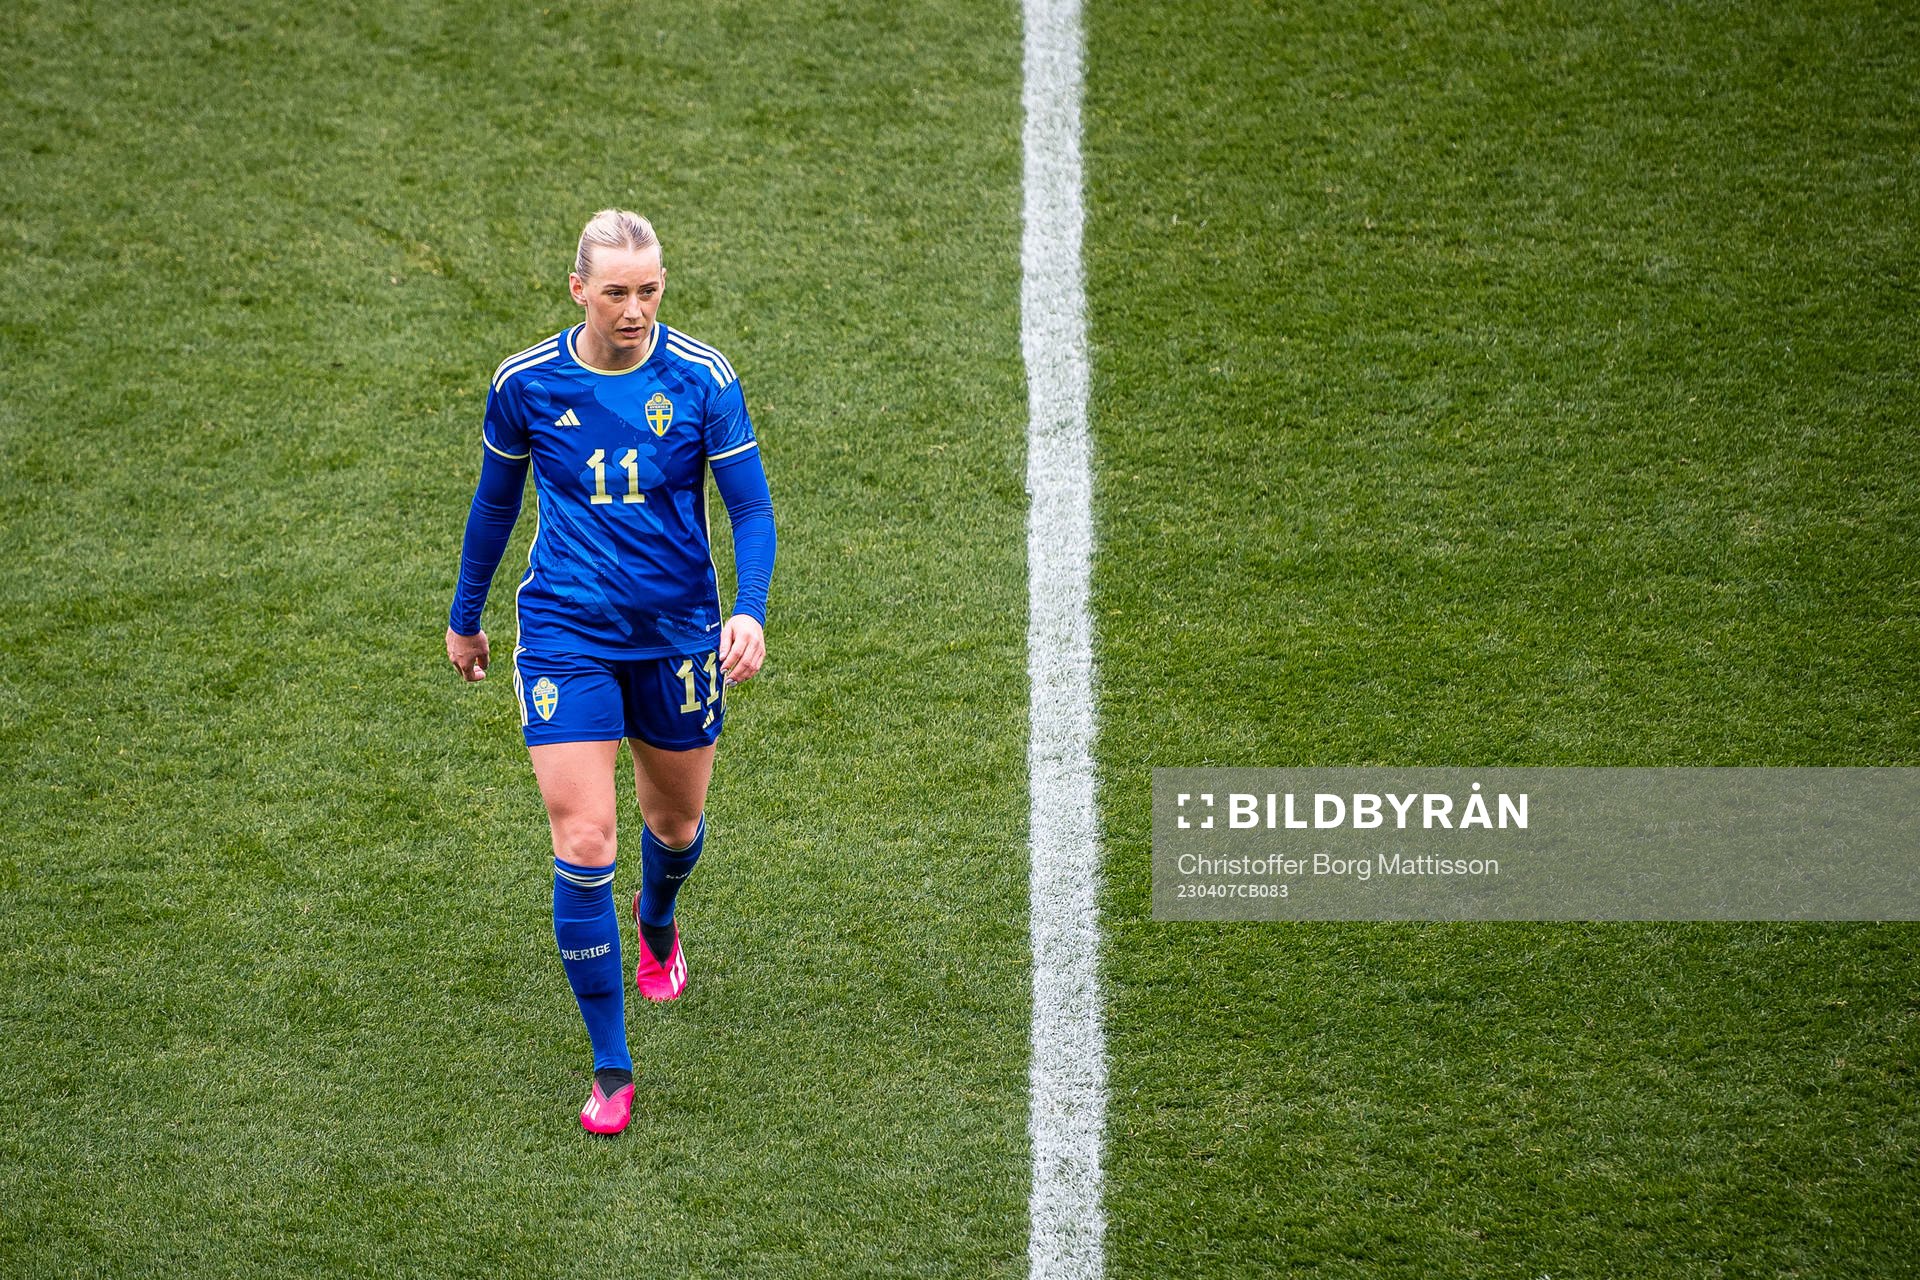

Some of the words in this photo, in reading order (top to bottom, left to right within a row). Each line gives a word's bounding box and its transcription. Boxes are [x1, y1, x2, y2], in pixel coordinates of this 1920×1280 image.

[586, 448, 645, 504] 11
[676, 651, 719, 714] 11
[561, 942, 611, 961] SVERIGE
